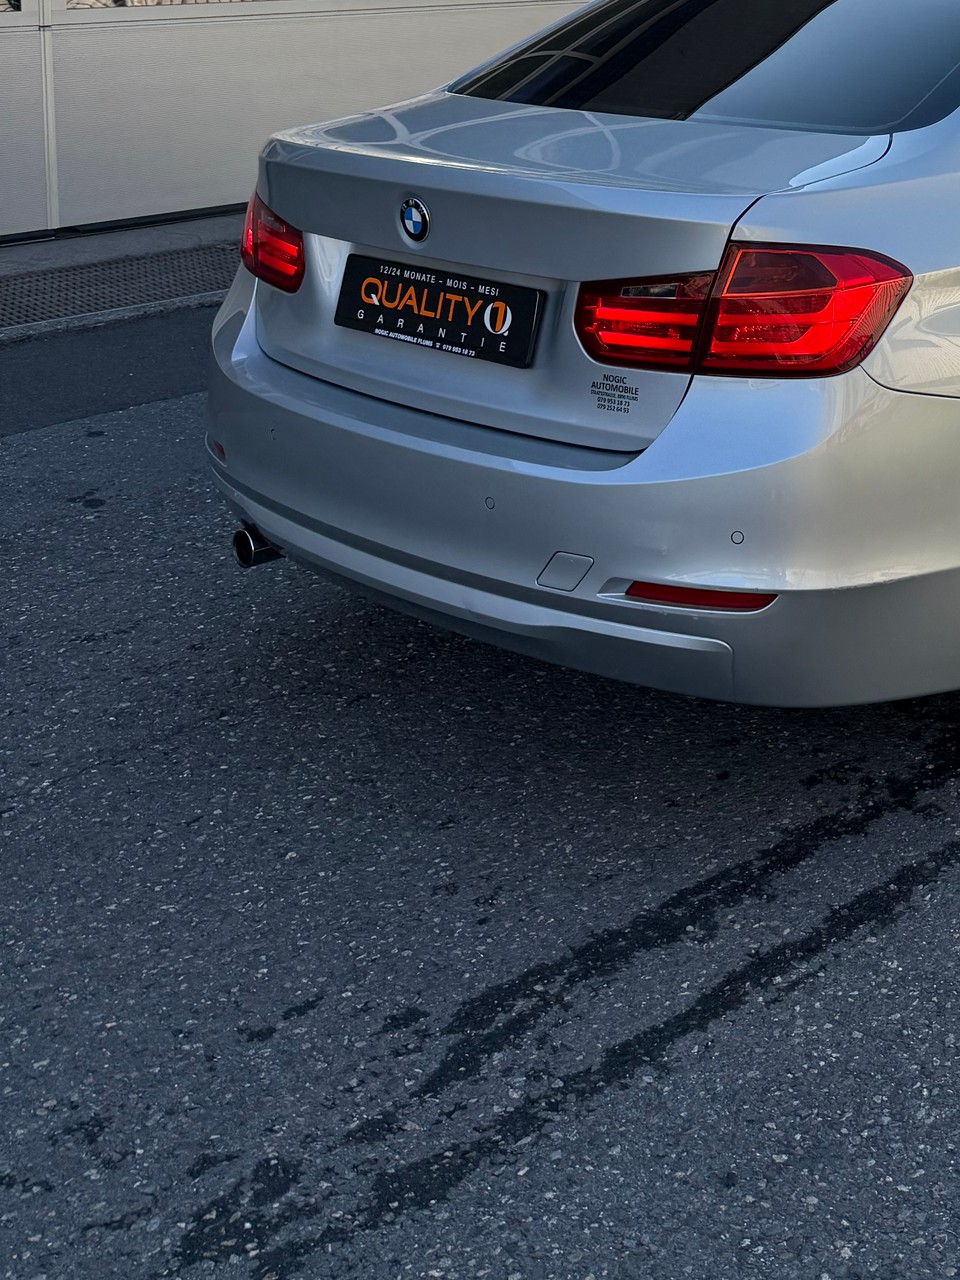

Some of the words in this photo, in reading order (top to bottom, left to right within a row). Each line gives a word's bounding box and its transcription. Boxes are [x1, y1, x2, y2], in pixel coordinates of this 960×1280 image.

[380, 265, 401, 276] 12/24
[403, 270, 436, 284] MONATE
[446, 278, 467, 290] MOIS
[478, 285, 499, 297] MESI
[361, 277, 484, 326] QUALITY
[358, 309, 507, 353] GARANTIE
[374, 328, 389, 336] NOGIC
[389, 332, 417, 343] AUTOMOBILE
[417, 338, 433, 347] FLUMS
[591, 382, 639, 395] AUTOMOBILE
[603, 374, 627, 384] NOGIC
